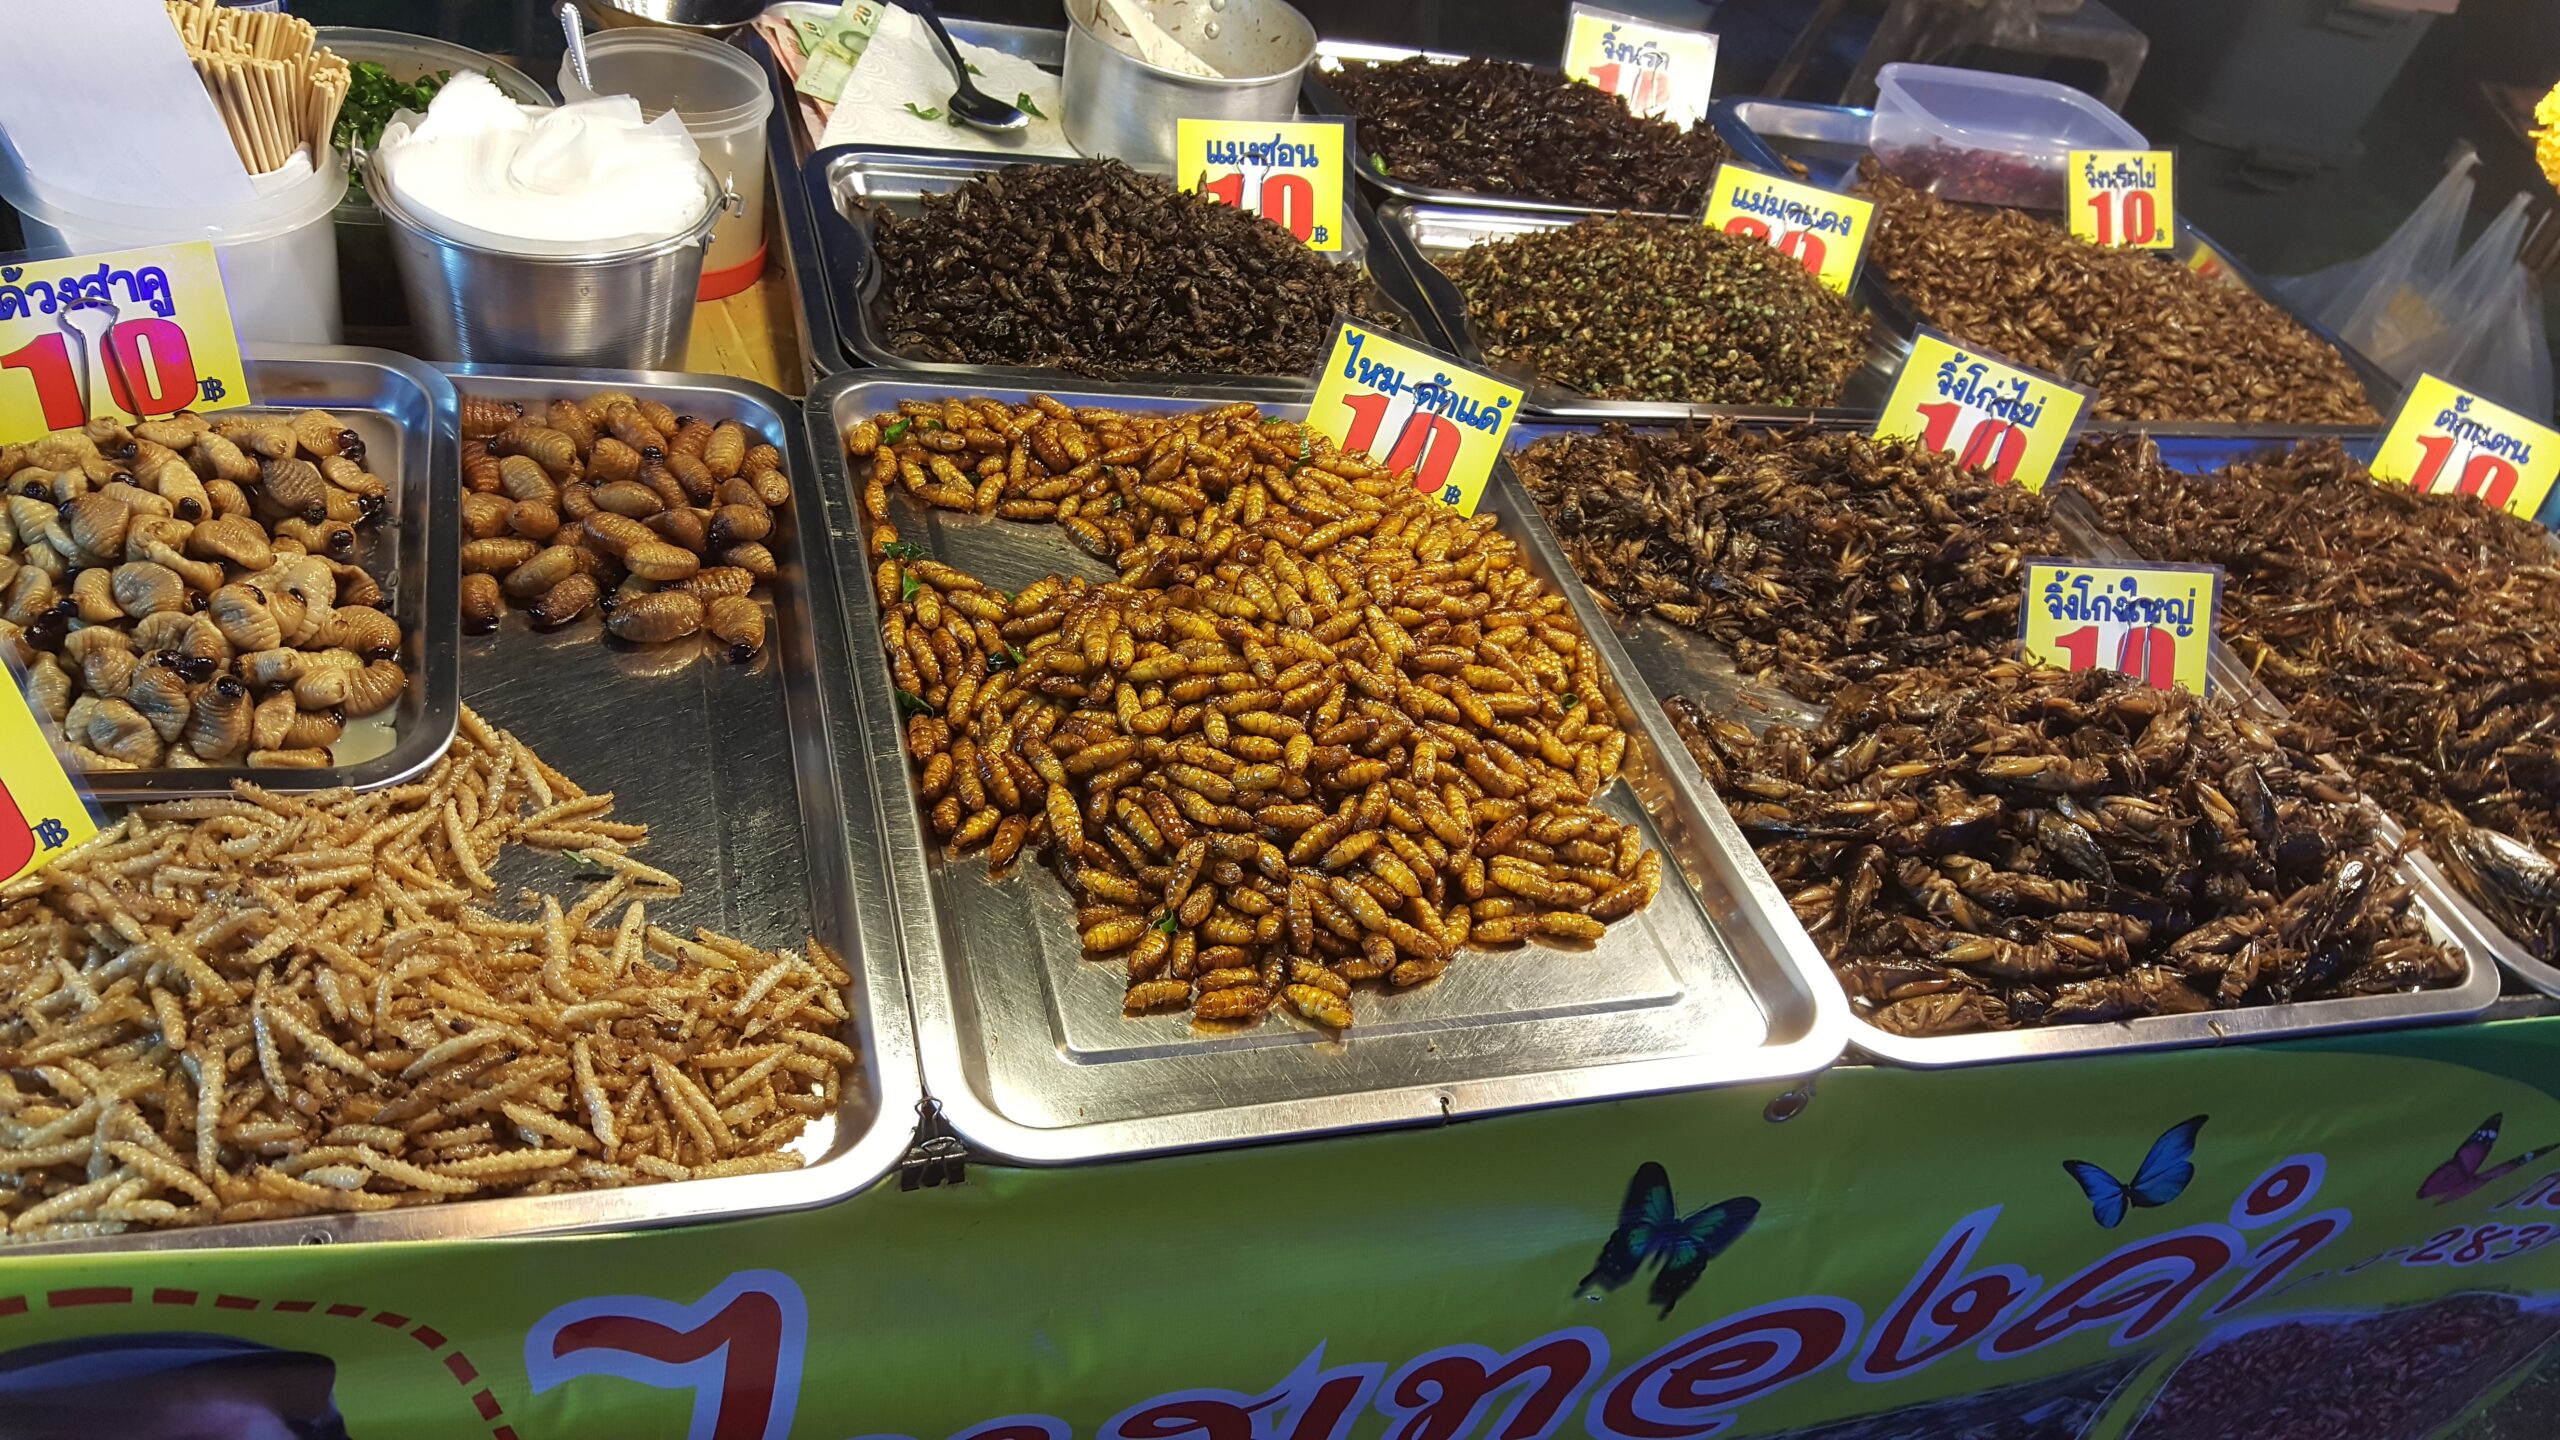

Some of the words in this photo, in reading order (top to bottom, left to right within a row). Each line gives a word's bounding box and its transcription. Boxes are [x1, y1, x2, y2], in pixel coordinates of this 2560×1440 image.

[2087, 190, 2156, 245] 10
[0, 262, 176, 320] ด้วงสาคู
[0, 317, 199, 431] 10
[1341, 392, 1462, 494] 10
[1916, 401, 2028, 487] 10
[2416, 434, 2519, 510] 10
[2054, 625, 2176, 692] 10
